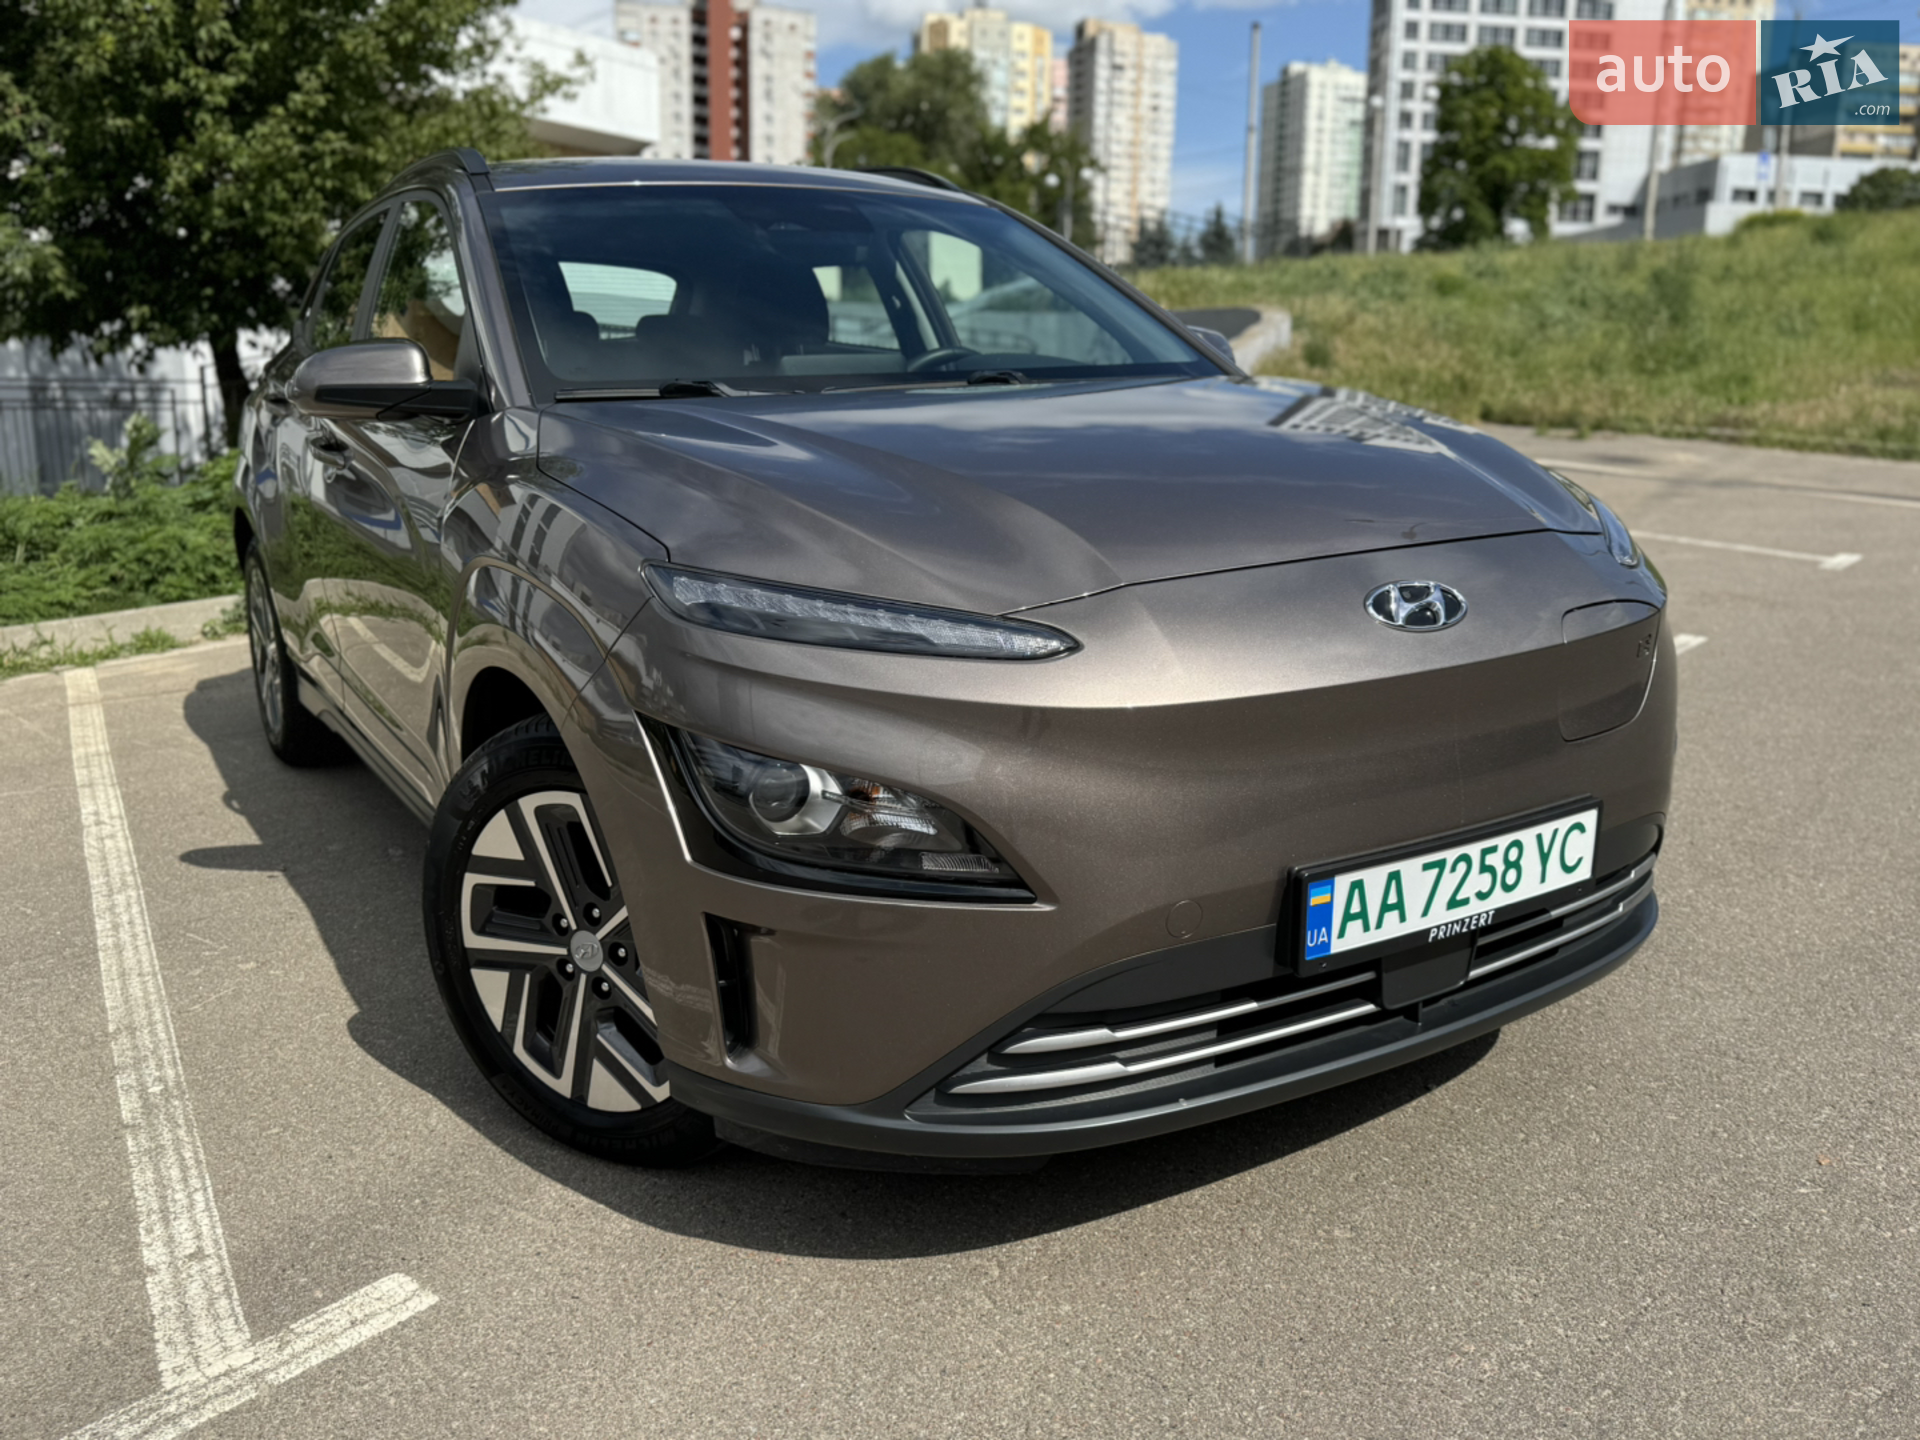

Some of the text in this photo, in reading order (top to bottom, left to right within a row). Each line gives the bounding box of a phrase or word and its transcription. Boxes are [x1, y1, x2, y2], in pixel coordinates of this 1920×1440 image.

[1337, 821, 1587, 939] AA 7258 YC
[1306, 926, 1329, 947] UA
[1428, 910, 1496, 942] PRINZERT
[508, 1087, 560, 1131] PRIMACY
[575, 1126, 677, 1150] MICHELIN
